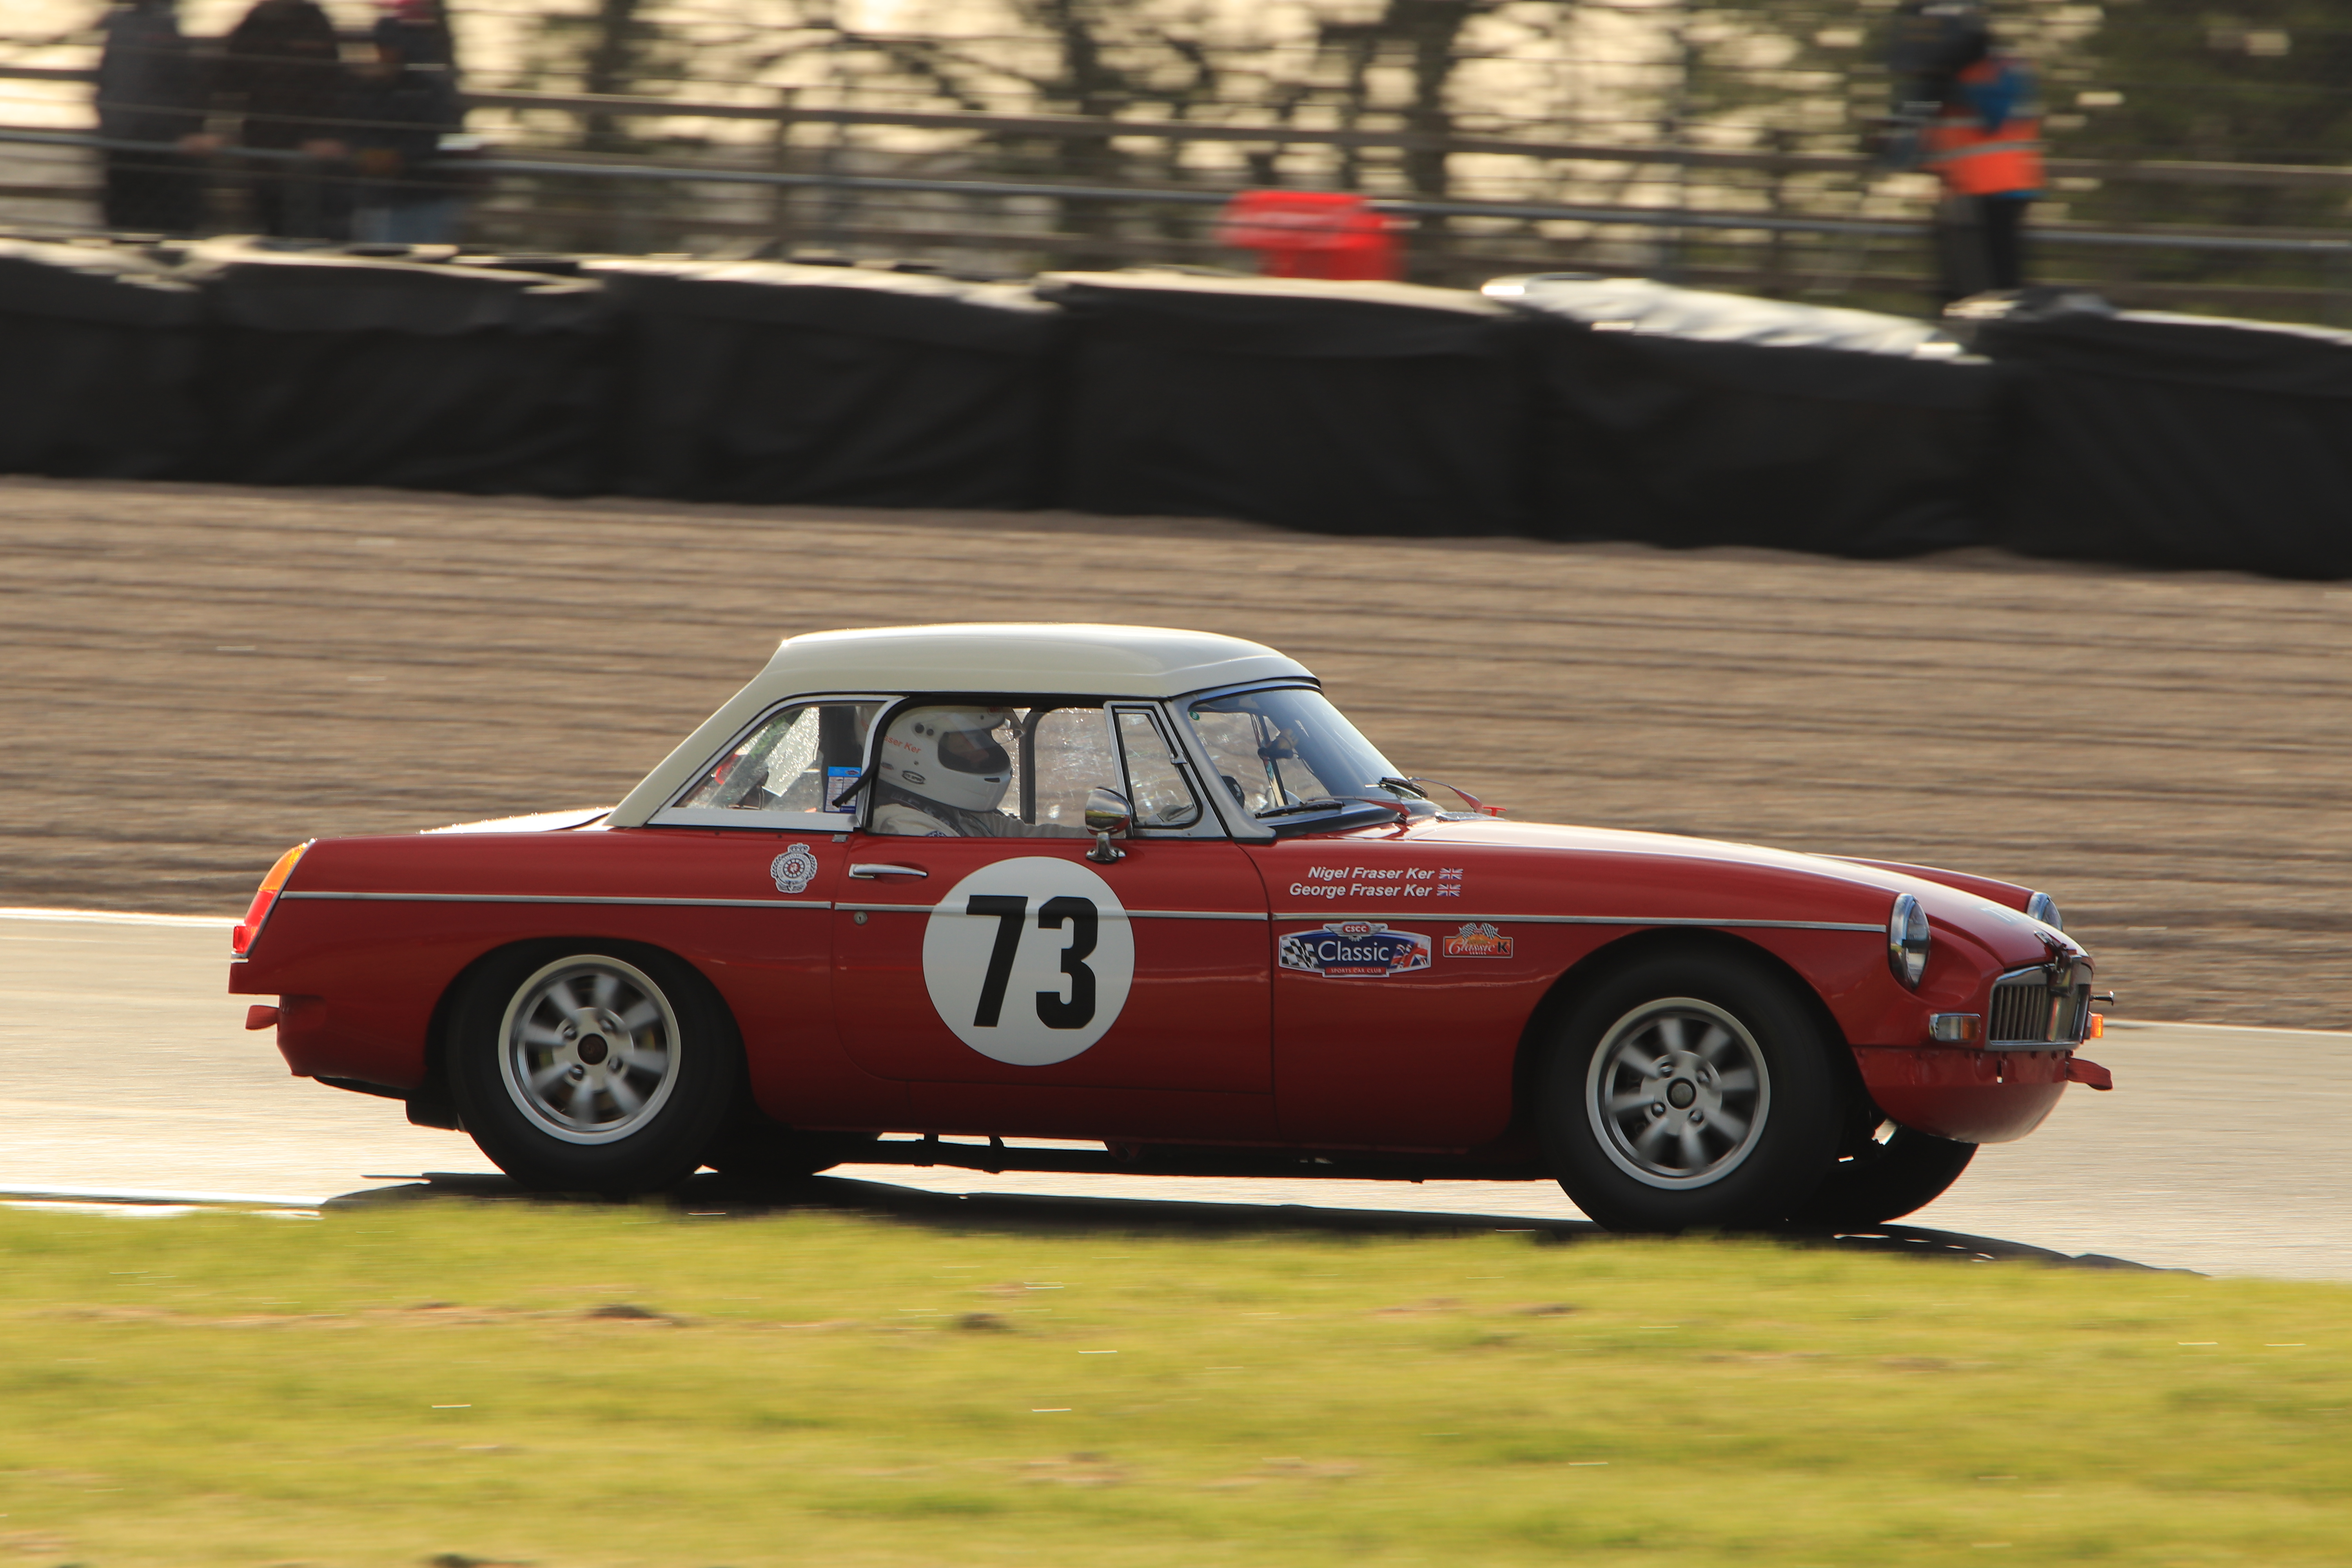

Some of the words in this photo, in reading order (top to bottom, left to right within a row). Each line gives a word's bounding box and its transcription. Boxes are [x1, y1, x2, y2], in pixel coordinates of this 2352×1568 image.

[884, 735, 903, 747] aser
[904, 742, 921, 753] Ker
[1308, 866, 1350, 882] Nigel
[1352, 867, 1404, 879] Fraser
[1405, 867, 1436, 879] Ker
[1289, 882, 1346, 899] George
[1350, 883, 1401, 896] Fraser
[1403, 884, 1433, 897] Ker
[1318, 940, 1389, 961] Classic
[1448, 938, 1495, 955] Classic
[1497, 941, 1510, 954] K
[966, 895, 1098, 1030] 73
